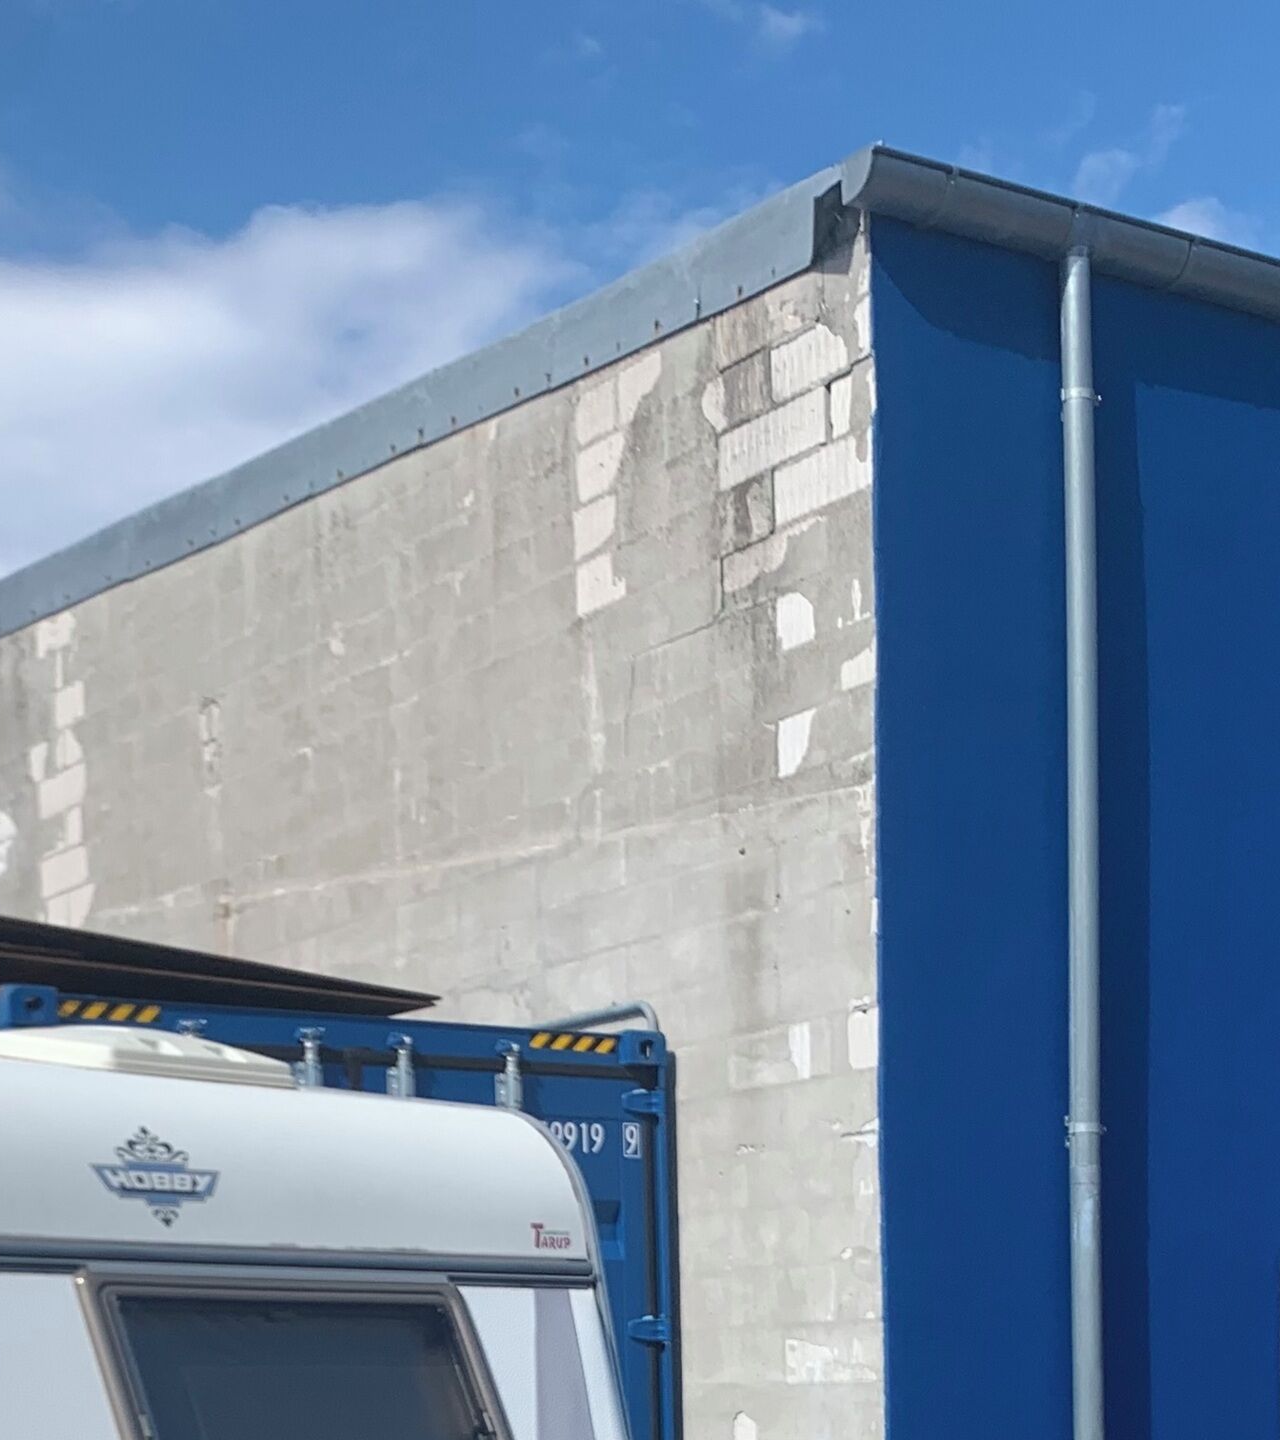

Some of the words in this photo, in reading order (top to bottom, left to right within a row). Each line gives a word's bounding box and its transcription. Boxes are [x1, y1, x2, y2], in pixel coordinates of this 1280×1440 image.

[543, 1121, 605, 1154] 9919
[624, 1124, 639, 1156] 9
[101, 1169, 213, 1192] HOBBY
